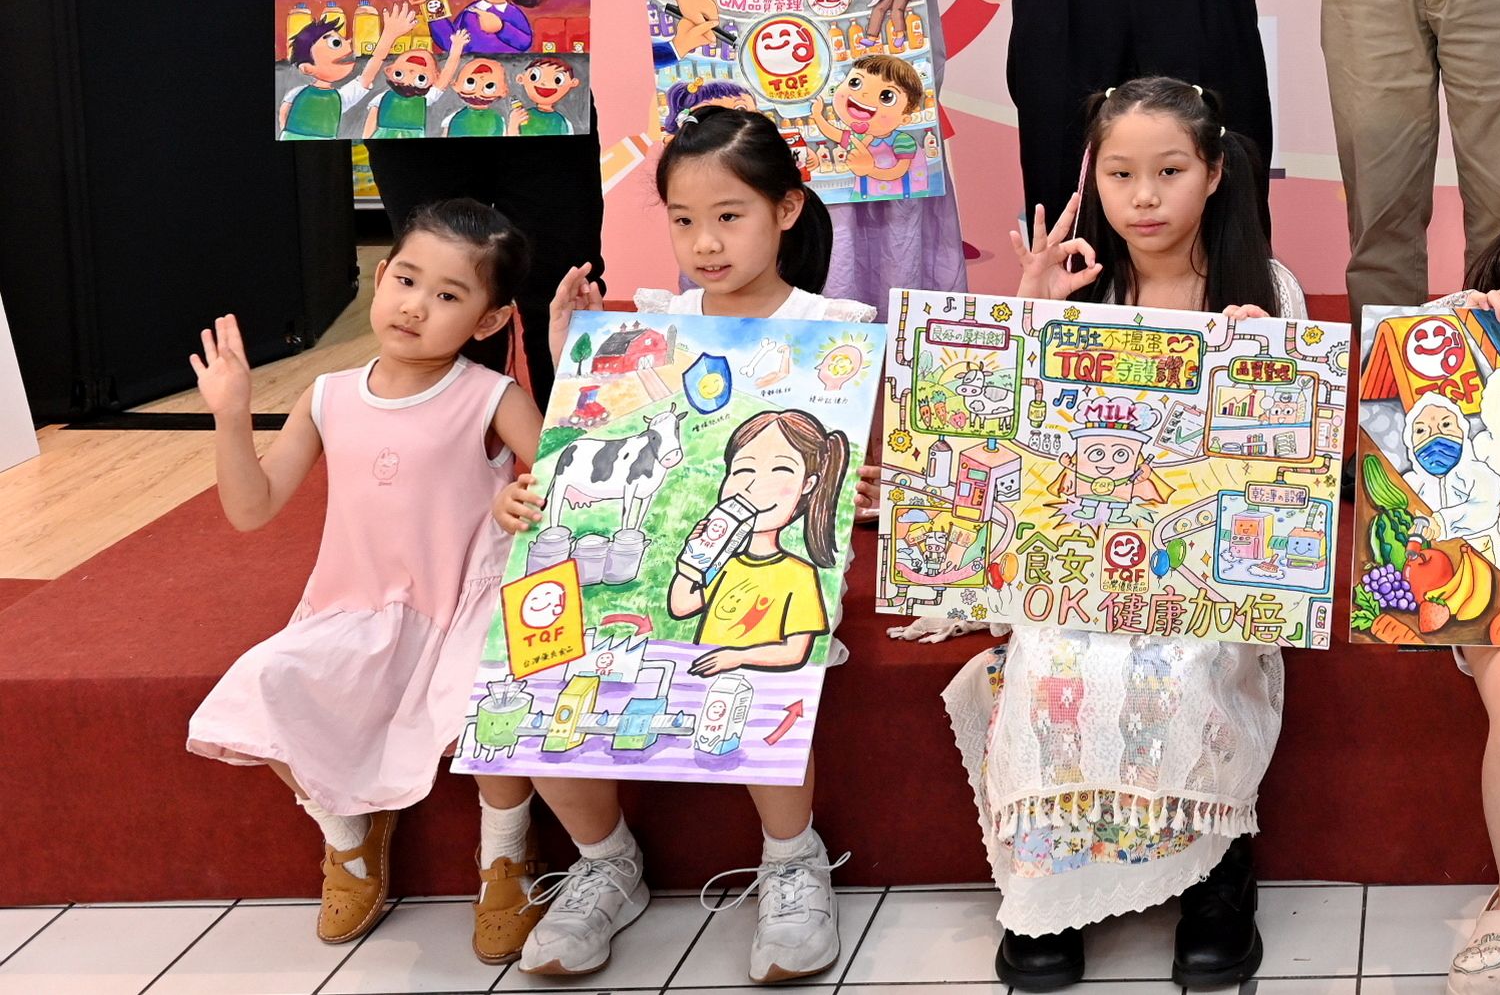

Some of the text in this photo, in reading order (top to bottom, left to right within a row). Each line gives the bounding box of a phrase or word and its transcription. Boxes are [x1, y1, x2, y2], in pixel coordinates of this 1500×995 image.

[768, 73, 809, 92] TQF
[1083, 403, 1139, 423] MILK
[1103, 567, 1146, 583] TQF
[522, 625, 565, 648] TQF
[703, 724, 724, 733] TQF
